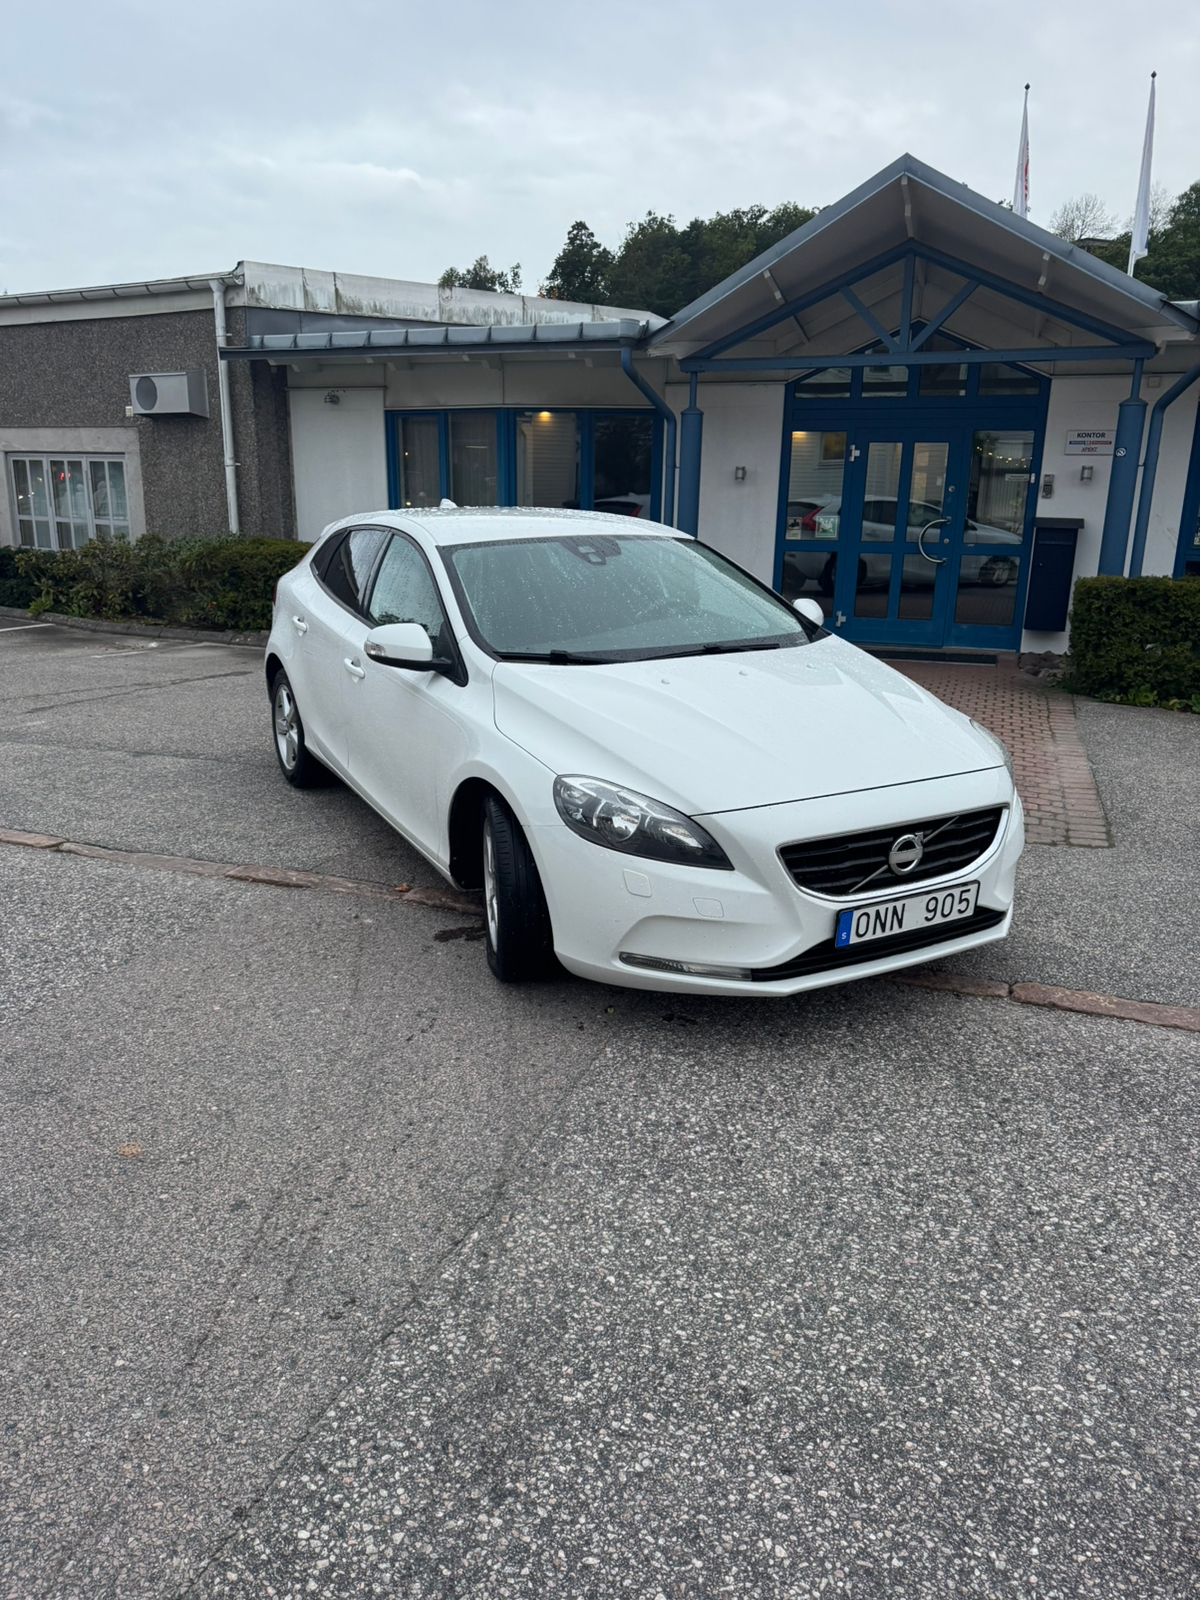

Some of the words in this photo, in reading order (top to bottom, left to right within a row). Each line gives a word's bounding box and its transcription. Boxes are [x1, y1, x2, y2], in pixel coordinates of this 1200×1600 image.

[855, 903, 906, 938] ONN
[924, 888, 971, 922] 905
[841, 932, 847, 940] S
